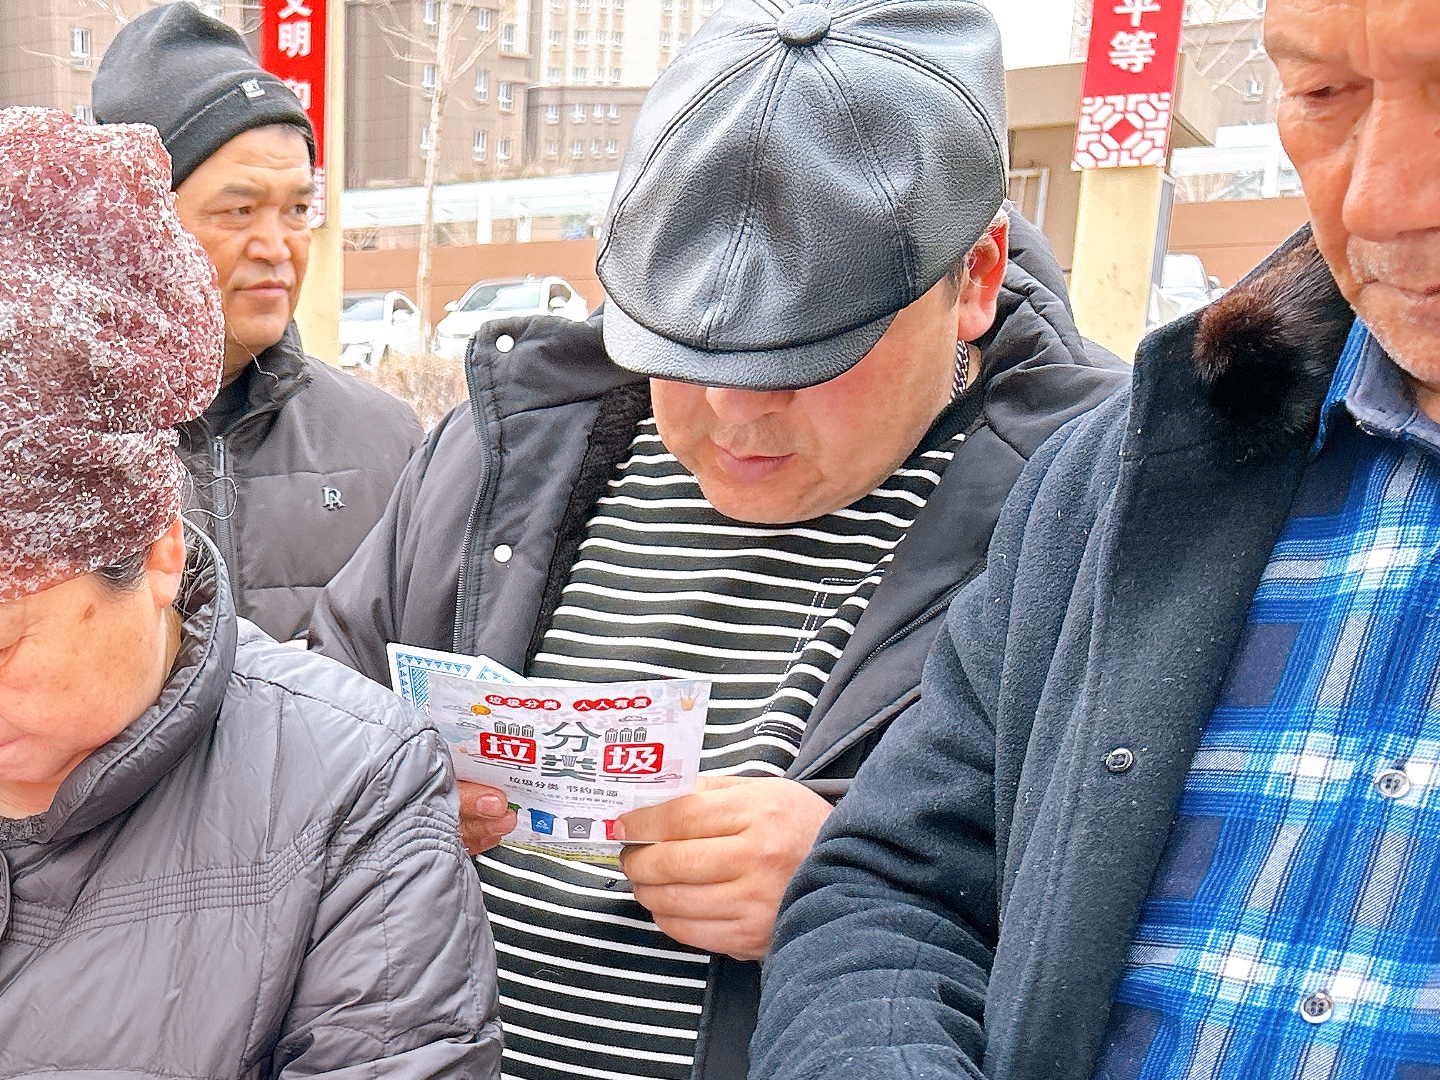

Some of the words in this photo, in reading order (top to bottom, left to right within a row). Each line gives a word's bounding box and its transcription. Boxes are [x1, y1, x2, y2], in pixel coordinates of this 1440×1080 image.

[1108, 0, 1161, 73] 平等
[489, 696, 558, 710] 垃圾分类
[509, 776, 559, 791] 垃圾分类
